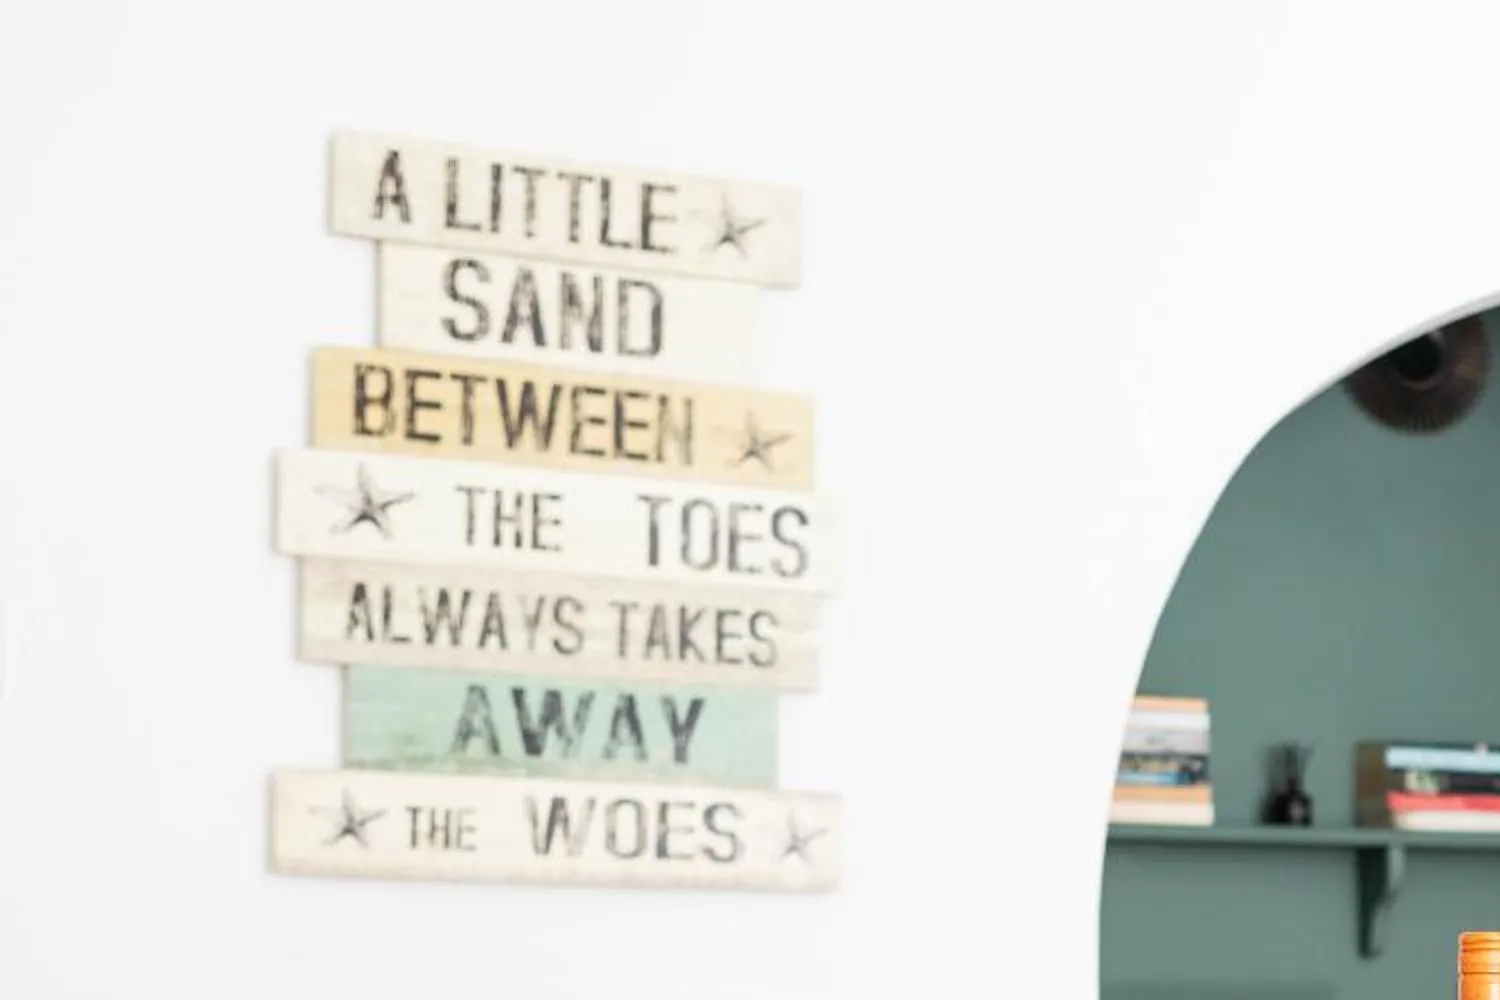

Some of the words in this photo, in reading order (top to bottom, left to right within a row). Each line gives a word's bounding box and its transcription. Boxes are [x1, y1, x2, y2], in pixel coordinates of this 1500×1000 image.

[371, 147, 413, 225] A
[443, 156, 681, 255] LITTLE
[440, 256, 665, 360] SAND
[351, 362, 696, 466] BETWEEN
[455, 484, 564, 553] THE
[636, 493, 812, 580] TOES
[344, 581, 586, 657] ALWAYS
[608, 600, 781, 669] TAKES
[452, 684, 706, 765] AWAY
[404, 805, 479, 853] THE
[524, 794, 746, 865] WOES
